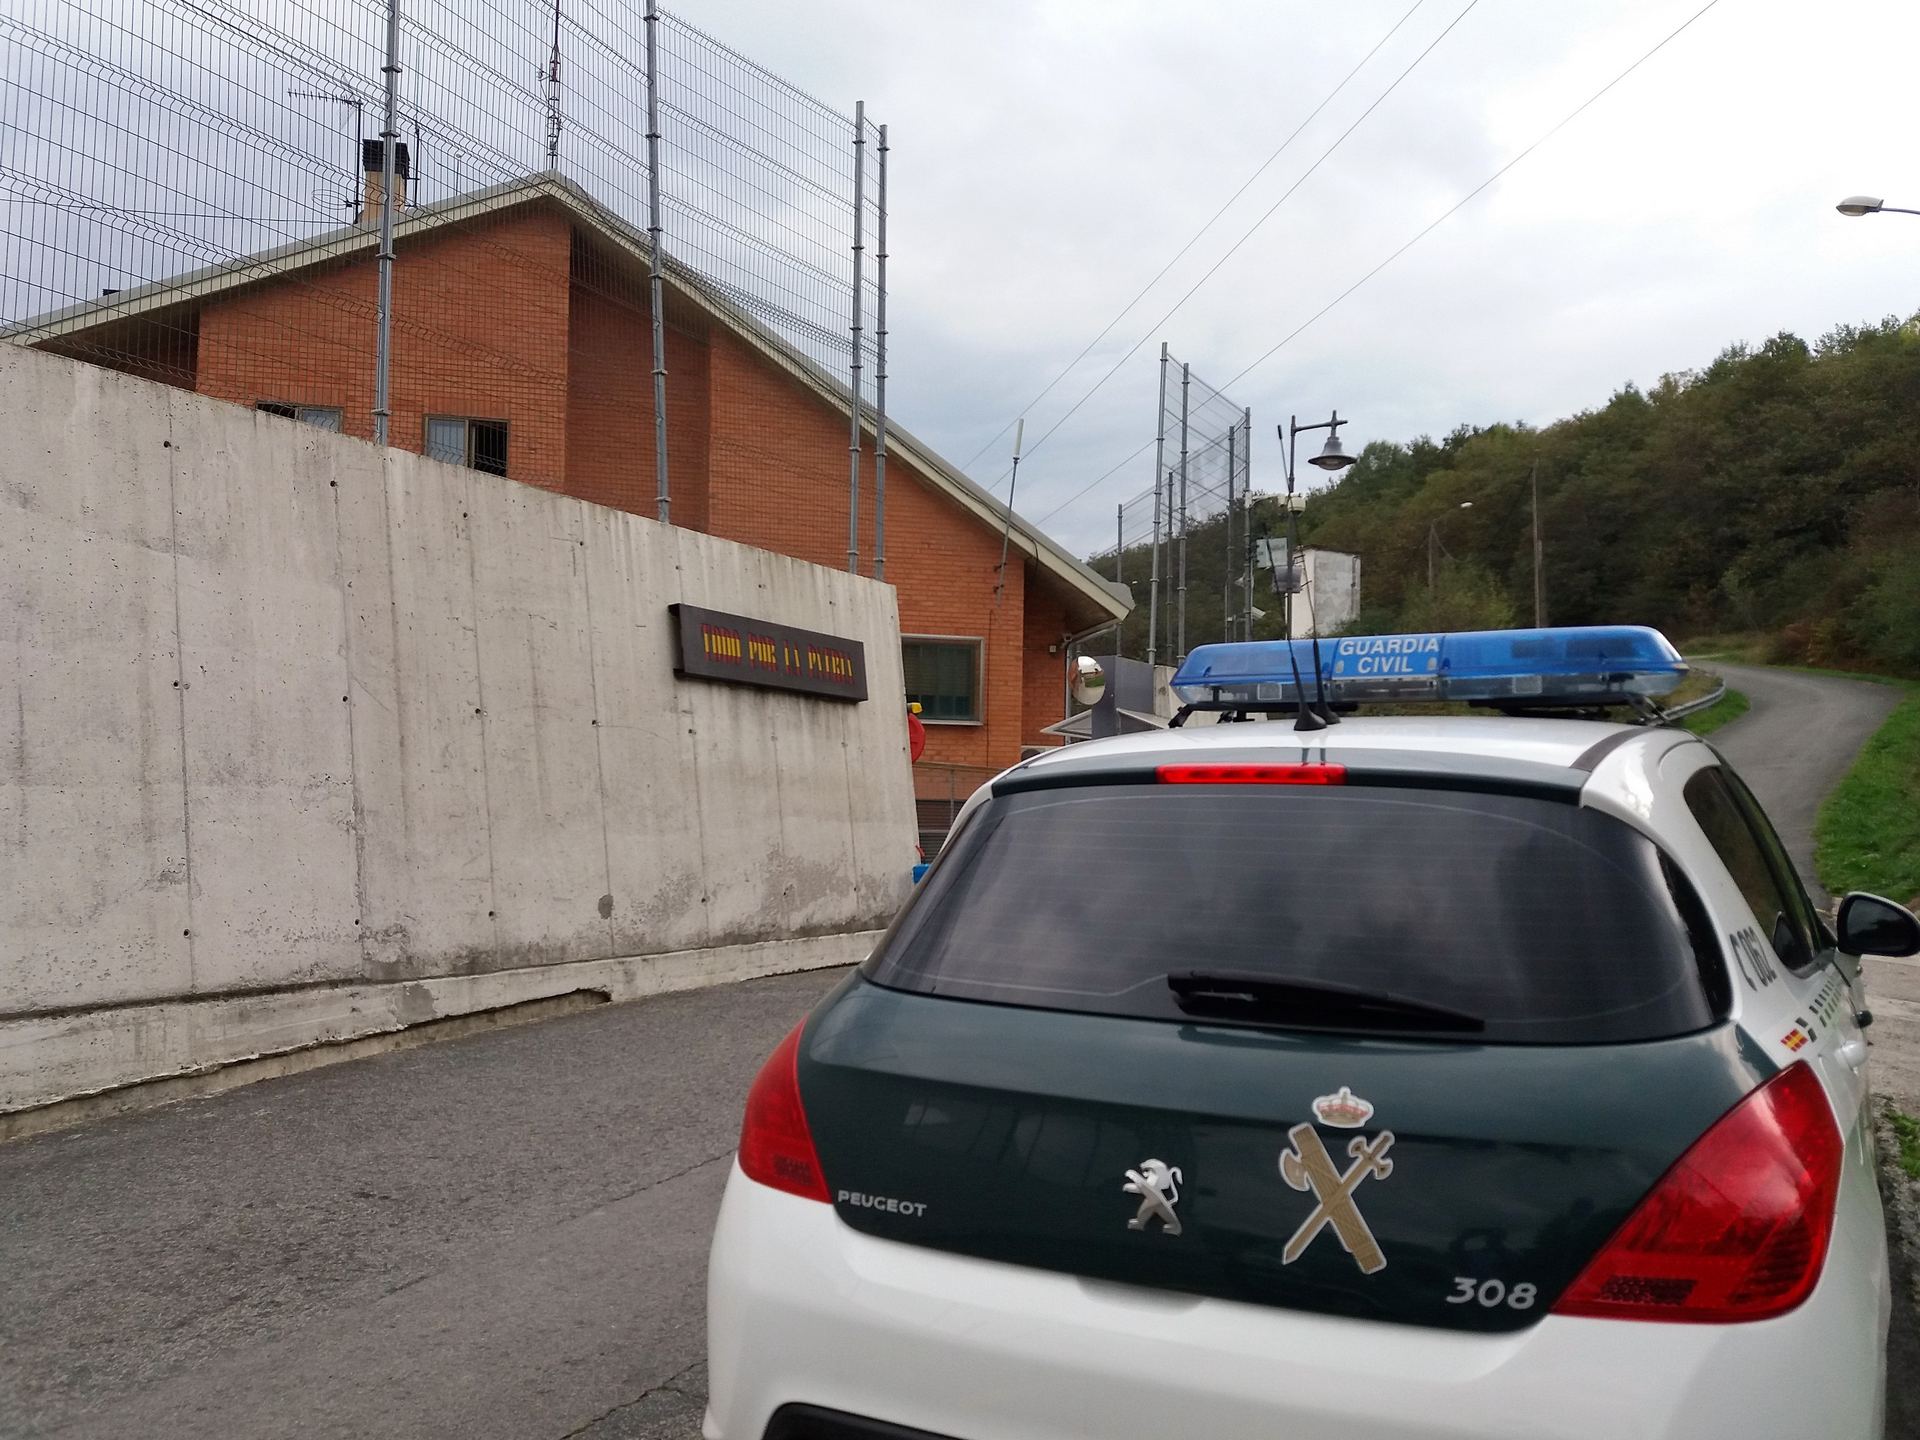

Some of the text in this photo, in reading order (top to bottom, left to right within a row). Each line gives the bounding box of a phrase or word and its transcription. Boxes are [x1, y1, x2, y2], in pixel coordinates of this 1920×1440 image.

[1339, 638, 1440, 656] GUARDIA
[1358, 656, 1414, 674] CIVIL
[838, 1189, 928, 1217] PEUGEOT
[1445, 1276, 1538, 1310] 308
